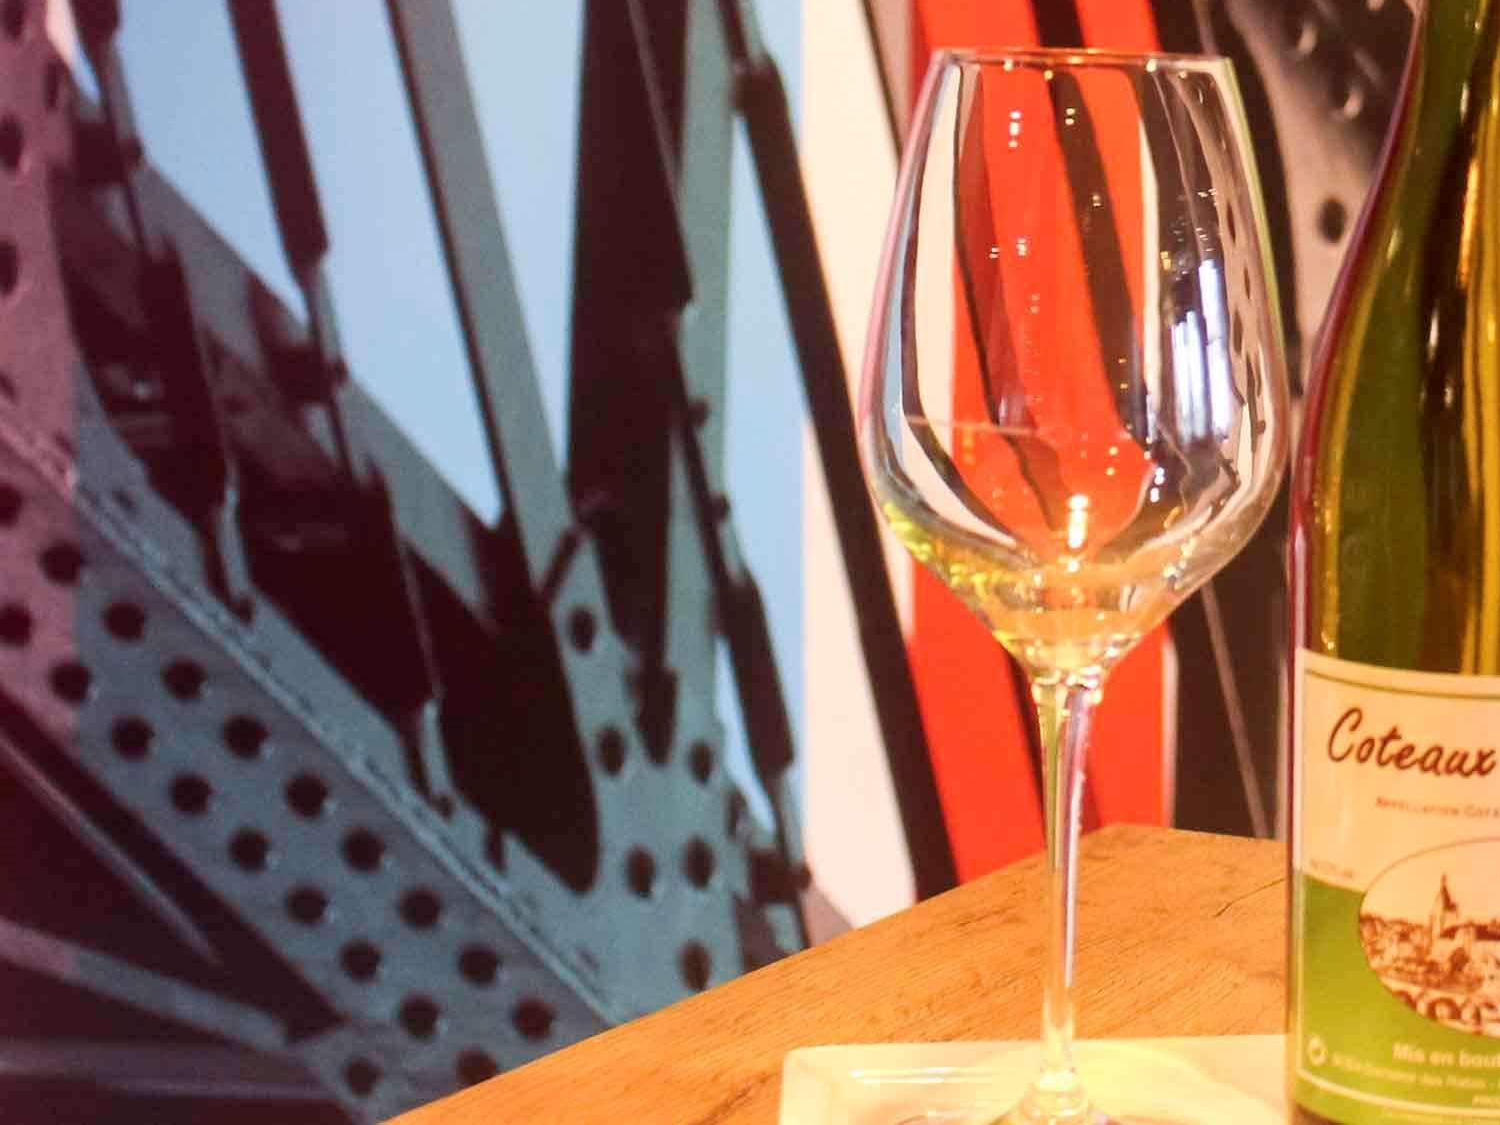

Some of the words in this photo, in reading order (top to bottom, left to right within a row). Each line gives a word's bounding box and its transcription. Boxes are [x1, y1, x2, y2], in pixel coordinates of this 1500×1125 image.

[1327, 706, 1497, 777] Coteaux
[1392, 1041, 1425, 1063] Mis
[1428, 1049, 1455, 1066] en
